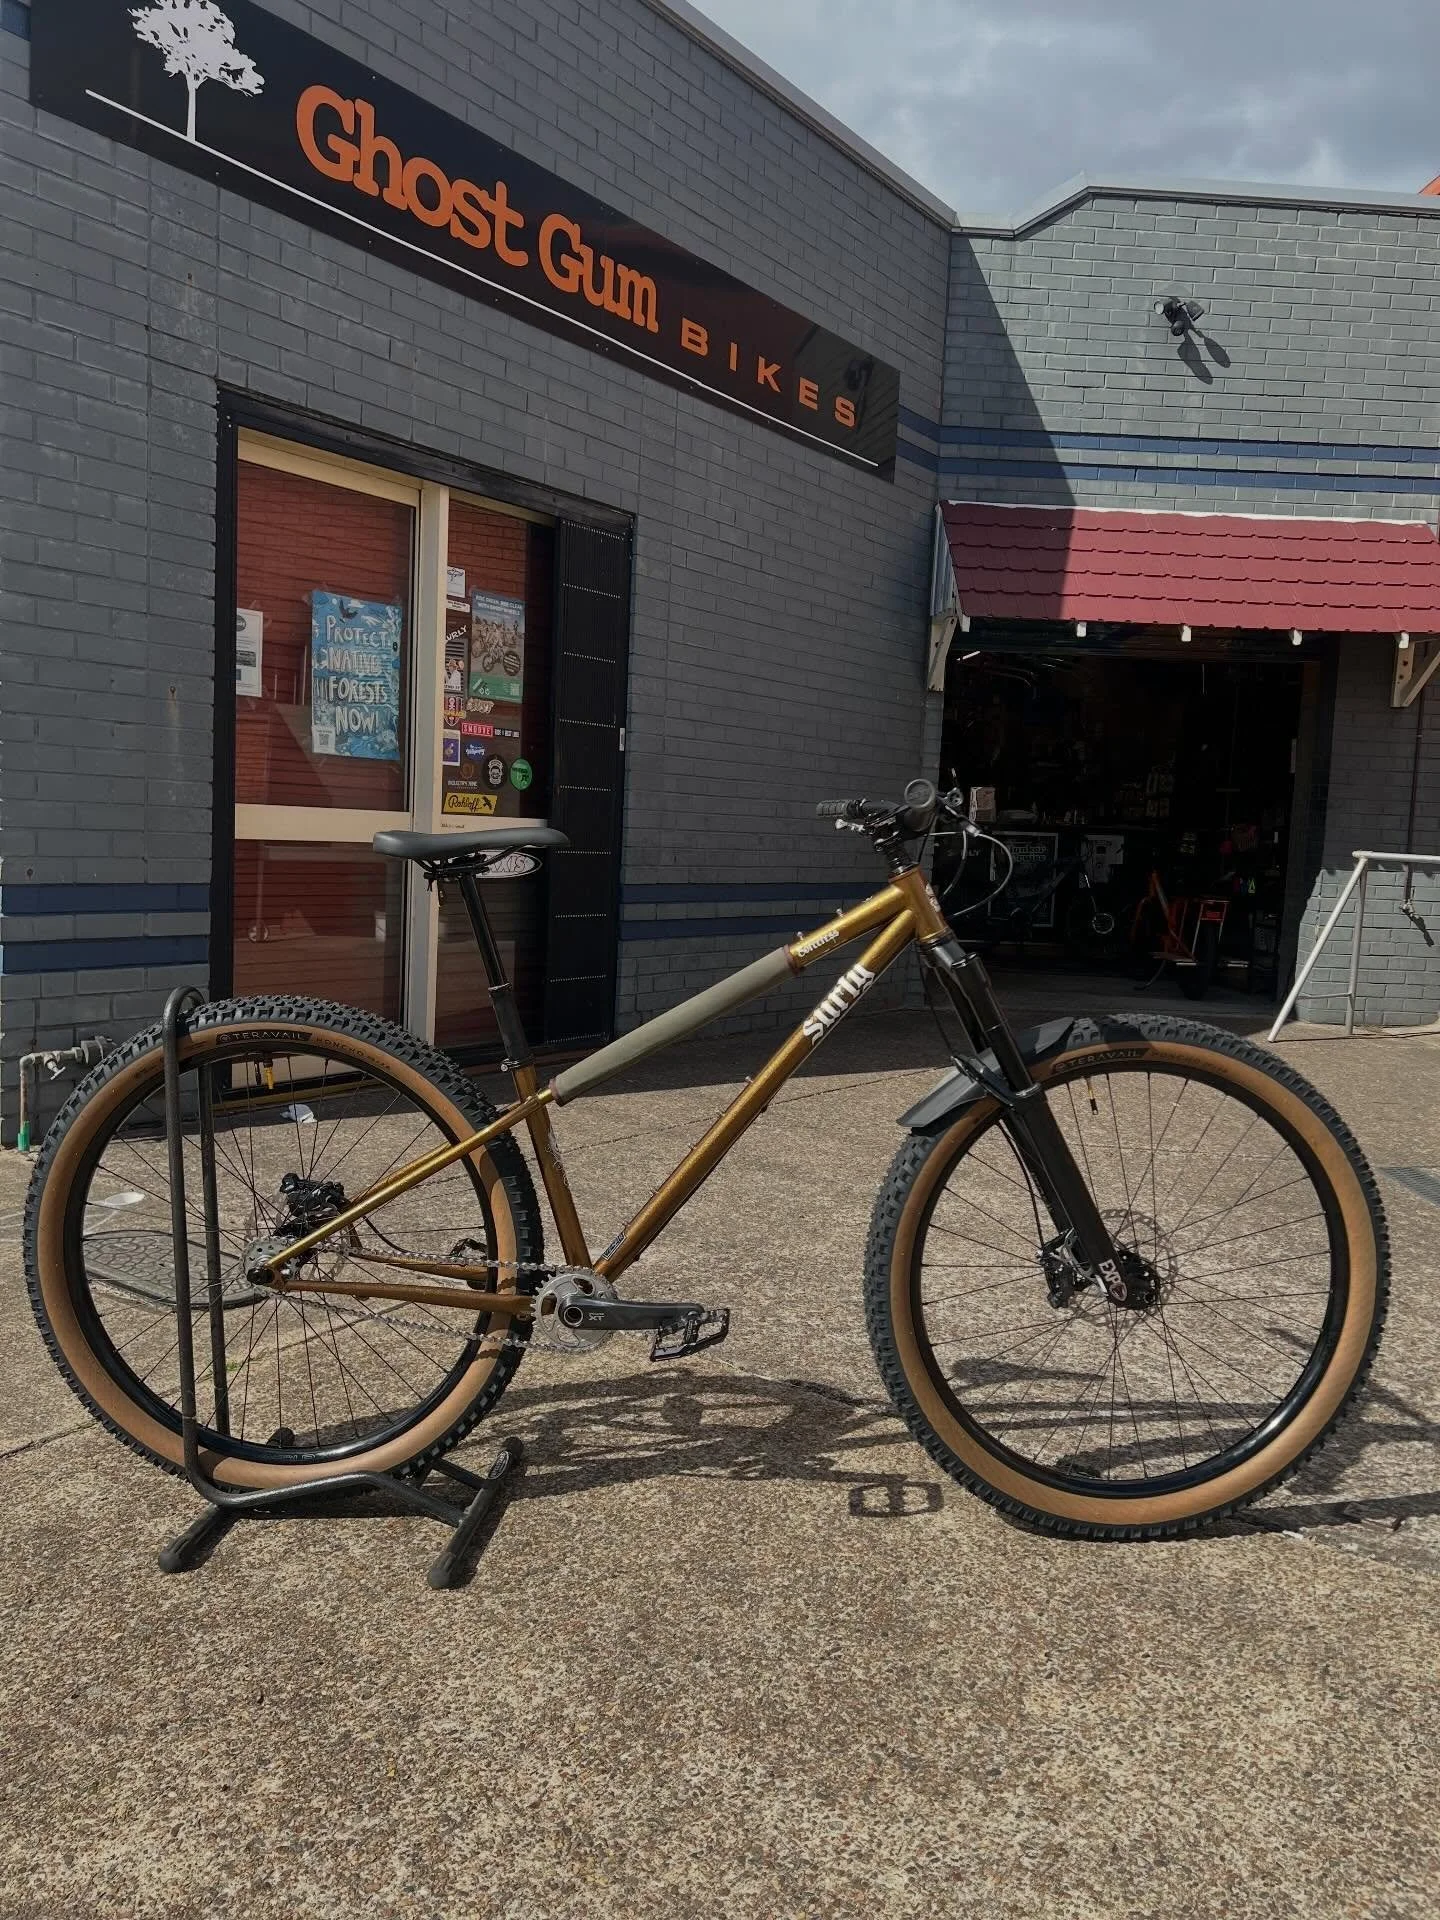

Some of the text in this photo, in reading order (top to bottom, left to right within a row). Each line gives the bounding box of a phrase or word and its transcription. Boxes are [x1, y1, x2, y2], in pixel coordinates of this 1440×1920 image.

[296, 85, 856, 429] Ghost Gum BIKES
[326, 615, 389, 648] PROTECT
[328, 646, 381, 674] NATIVE
[328, 675, 388, 704] FORESTS
[335, 705, 379, 736] NOW!
[233, 1030, 301, 1042] TERAVAIL
[1069, 1049, 1140, 1066] TERAVAIL
